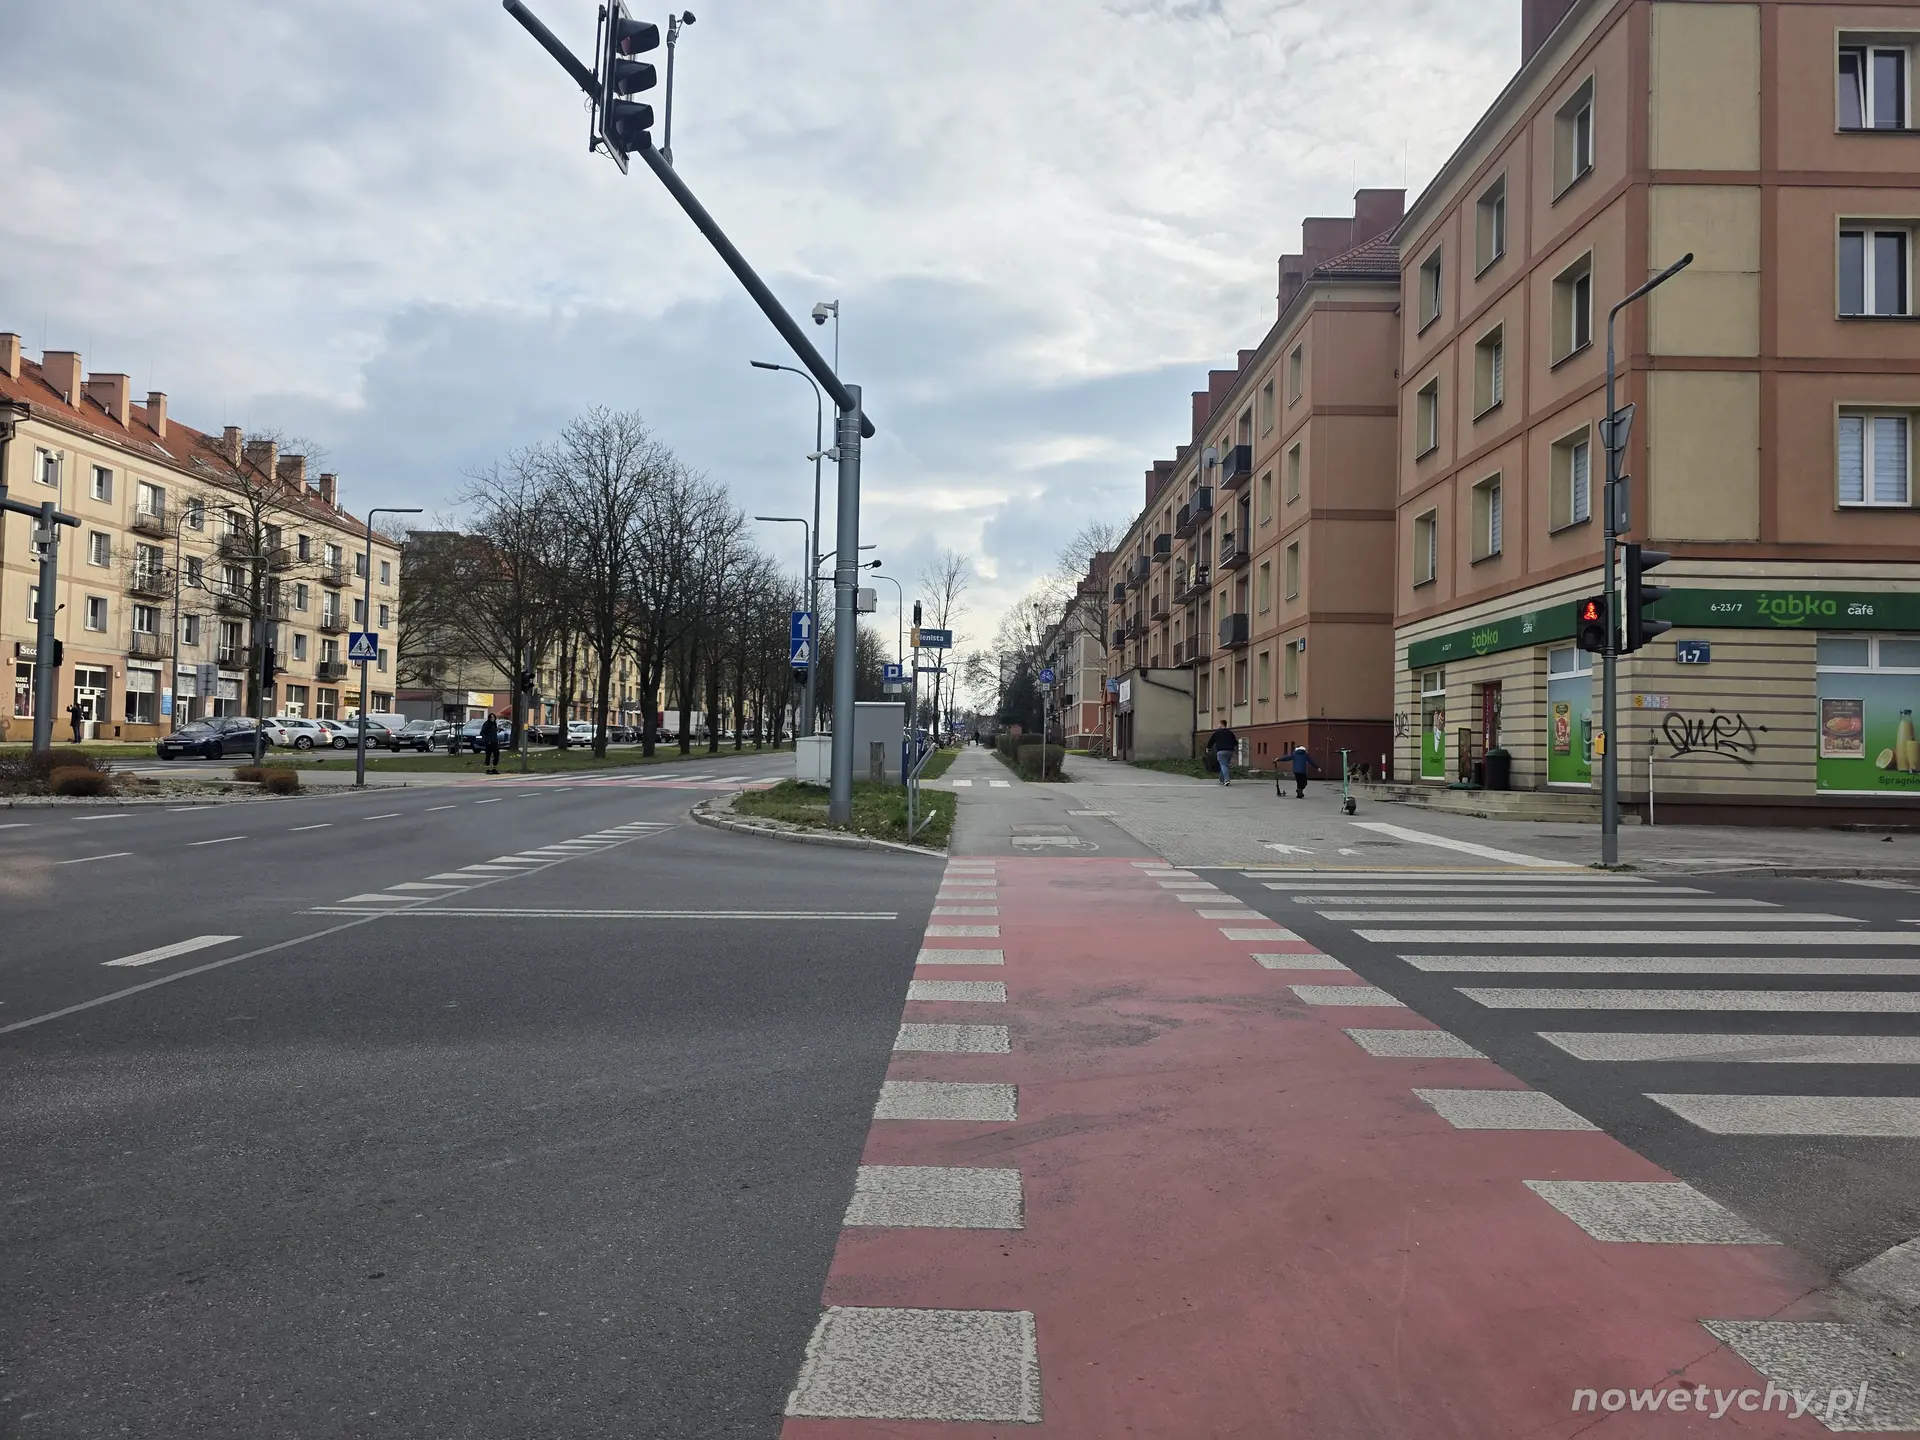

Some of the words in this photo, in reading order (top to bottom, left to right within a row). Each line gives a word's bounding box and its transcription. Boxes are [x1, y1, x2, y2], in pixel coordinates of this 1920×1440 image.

[1711, 603, 1742, 612] 6-23/7
[1757, 593, 1837, 616] żabka
[1472, 628, 1499, 649] żabka
[1679, 650, 1700, 663] 1-7
